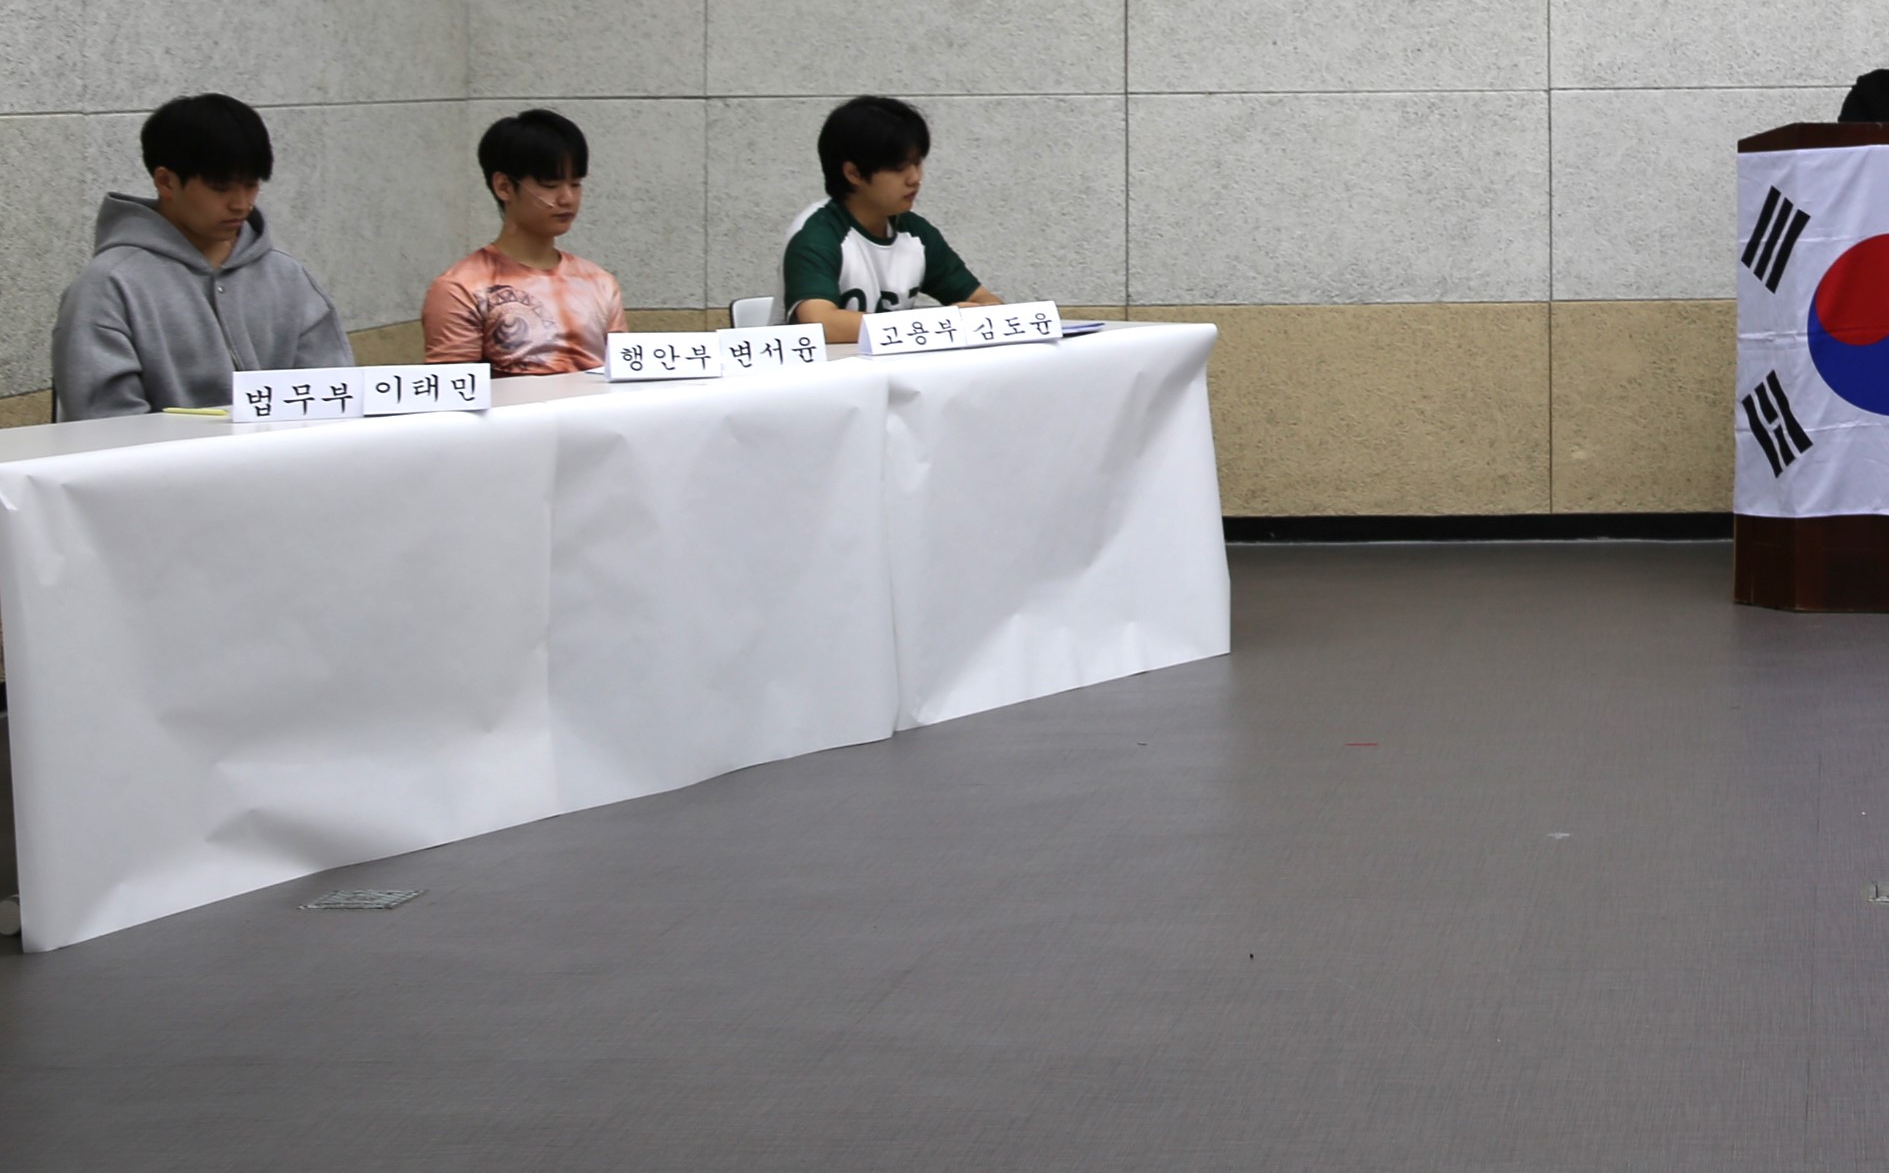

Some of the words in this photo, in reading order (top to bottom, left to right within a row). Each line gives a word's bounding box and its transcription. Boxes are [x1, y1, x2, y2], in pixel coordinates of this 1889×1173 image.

[879, 318, 958, 347] 고용부
[620, 344, 713, 372] 행안부
[729, 336, 817, 368] 변서윤
[245, 382, 355, 417] 법무부
[375, 373, 477, 404] 이태민
